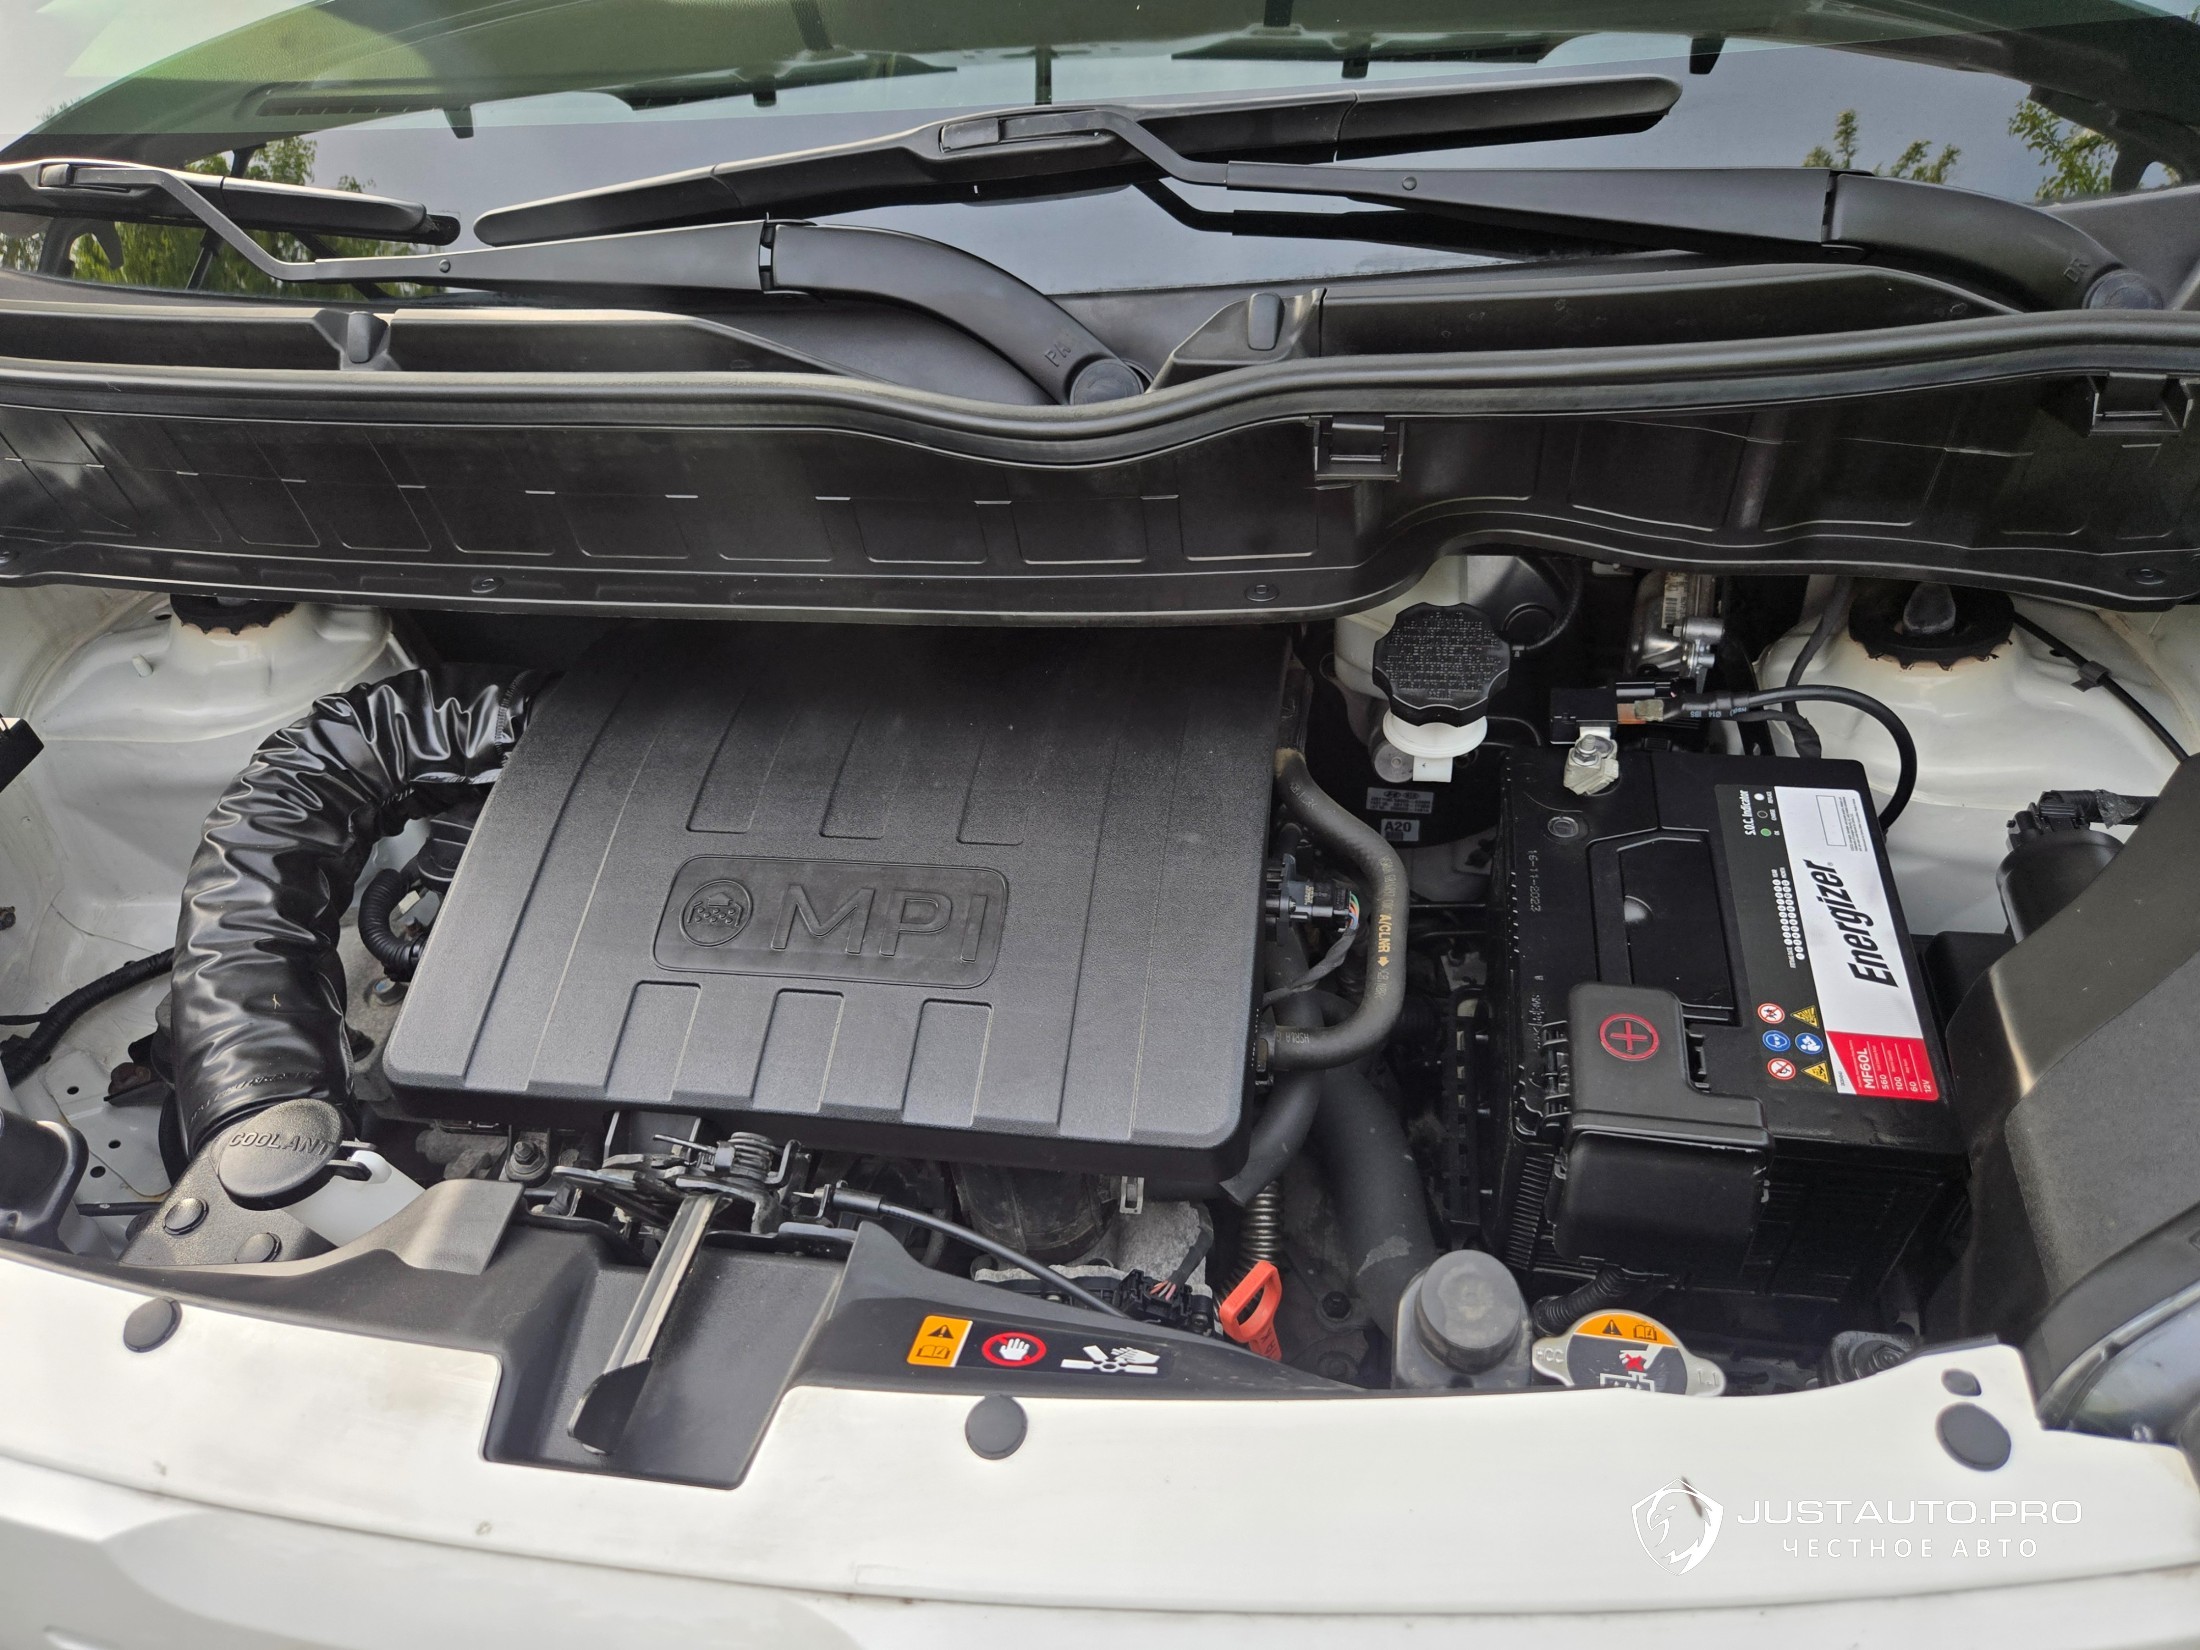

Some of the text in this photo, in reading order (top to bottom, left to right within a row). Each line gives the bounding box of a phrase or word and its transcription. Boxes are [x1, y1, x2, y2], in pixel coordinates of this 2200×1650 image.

[1739, 790, 1757, 836] S.O.C. Indicator
[1385, 820, 1412, 832] A20
[770, 883, 988, 962] MPI
[1378, 914, 1393, 953] A/CLNR
[1803, 858, 1899, 988] Energizer
[1857, 1048, 1876, 1089] MF60L
[1879, 1074, 1890, 1090] 560
[1894, 1076, 1904, 1091] 100
[1909, 1081, 1918, 1092] 60
[1922, 1079, 1932, 1093] 12V
[229, 1131, 330, 1156] COOLANT
